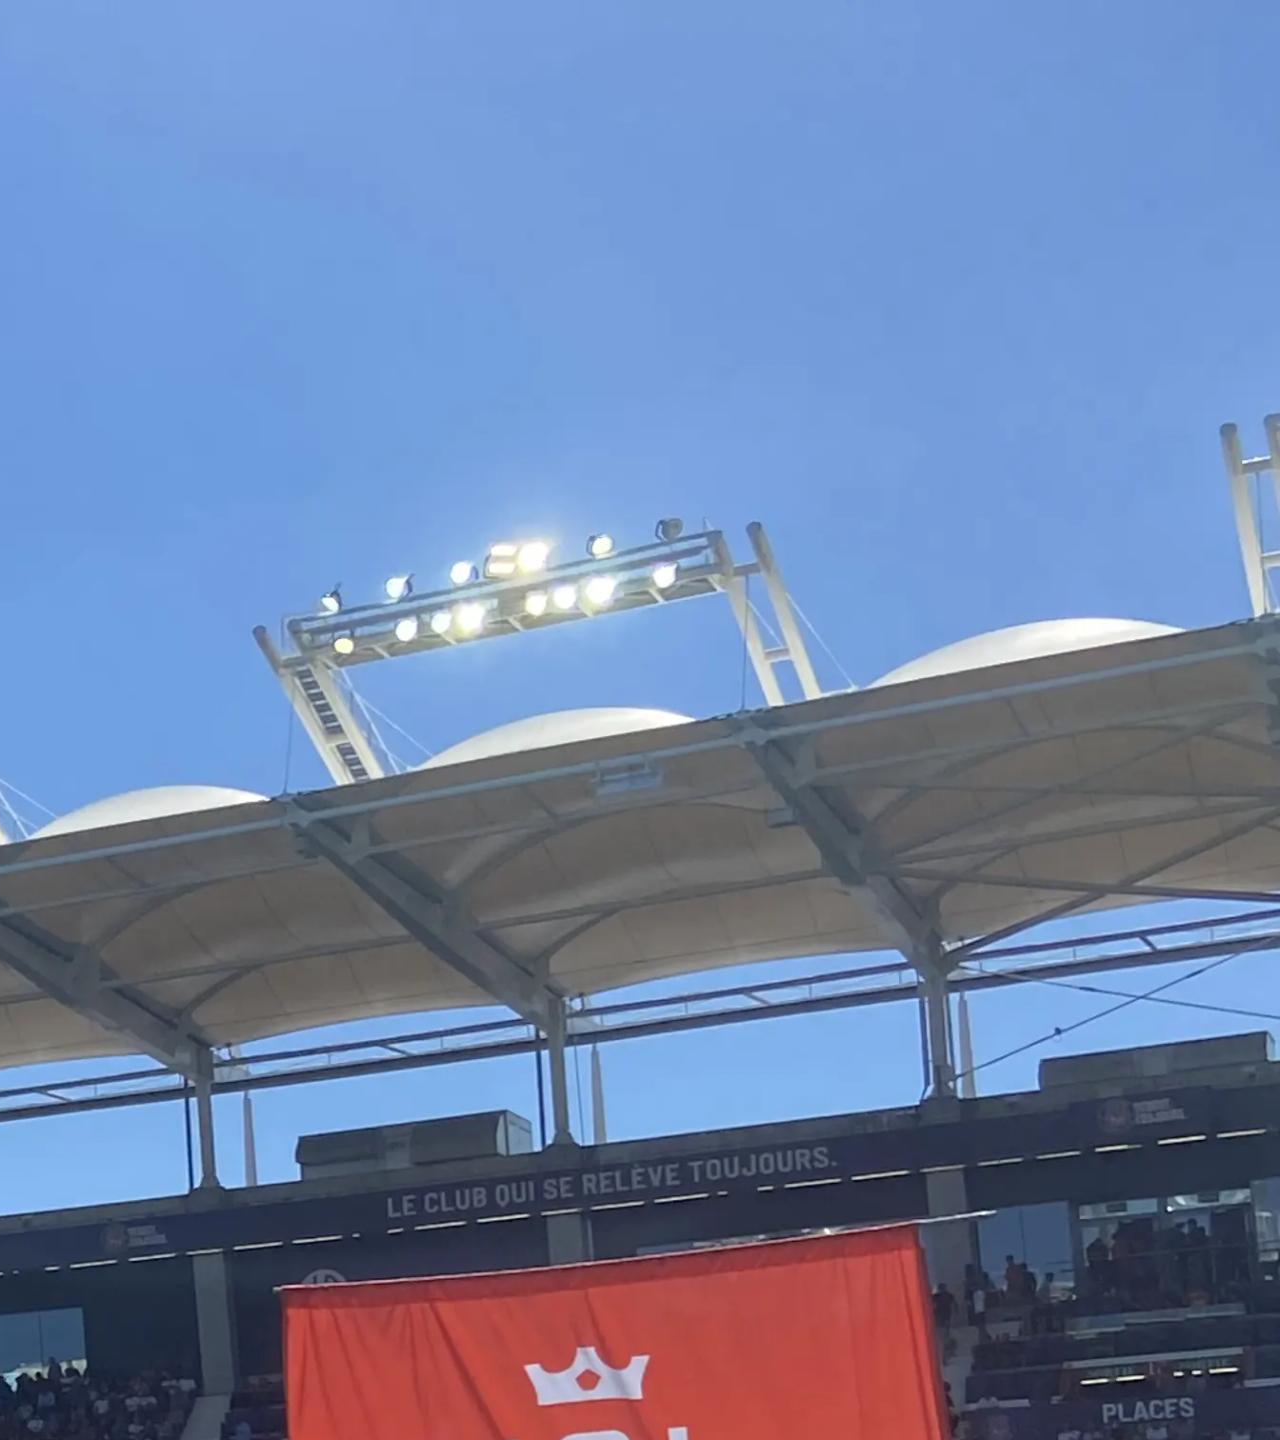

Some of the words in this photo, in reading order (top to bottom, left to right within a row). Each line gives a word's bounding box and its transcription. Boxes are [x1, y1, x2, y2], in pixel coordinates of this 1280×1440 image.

[387, 1195, 417, 1218] LE
[423, 1185, 488, 1213] CLUB
[496, 1181, 535, 1208] QUI
[543, 1176, 574, 1199] SE
[688, 1146, 838, 1182] TOUJOURS.
[1101, 1397, 1195, 1424] PLACES
